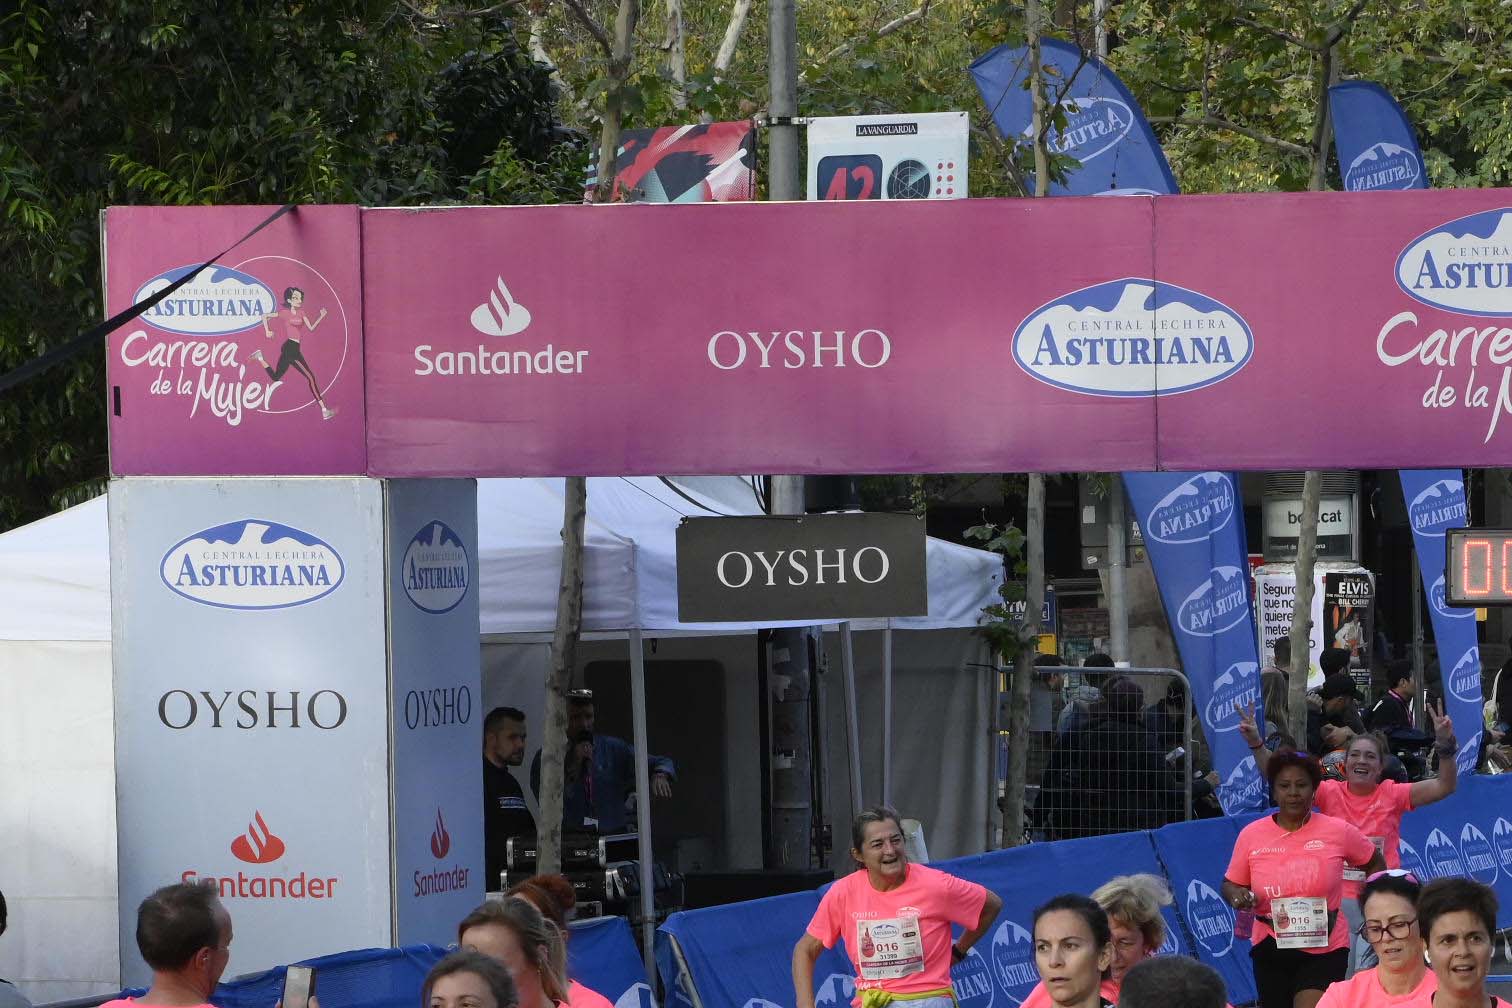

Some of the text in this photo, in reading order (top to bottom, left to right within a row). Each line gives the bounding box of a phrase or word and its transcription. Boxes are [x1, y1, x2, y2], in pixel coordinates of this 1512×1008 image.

[867, 123, 916, 135] VANGUARDIA
[215, 288, 260, 296] LECHERA
[1068, 318, 1227, 332] CENTRAL LECHERA
[121, 330, 238, 367] Carrera
[414, 344, 588, 376] Santander
[707, 328, 891, 369] OYSHO
[1031, 323, 1234, 367] ASTURIANA
[150, 366, 283, 426] de la Mujer
[1422, 370, 1457, 408] de
[1464, 368, 1489, 407] la
[175, 553, 332, 587] ASTURIANA
[203, 550, 325, 561] CENTRAL LECHERA
[717, 546, 890, 588] OYSHO
[407, 556, 466, 590] ASTURIANA
[1338, 582, 1369, 595] ELVIS
[1264, 600, 1280, 611] que
[158, 689, 348, 729] OYSHO
[405, 685, 472, 730] OYSHO
[414, 863, 469, 898] Santander
[1264, 886, 1281, 898] TU
[876, 942, 899, 952] 016
[1000, 958, 1040, 988] ASTURIA
